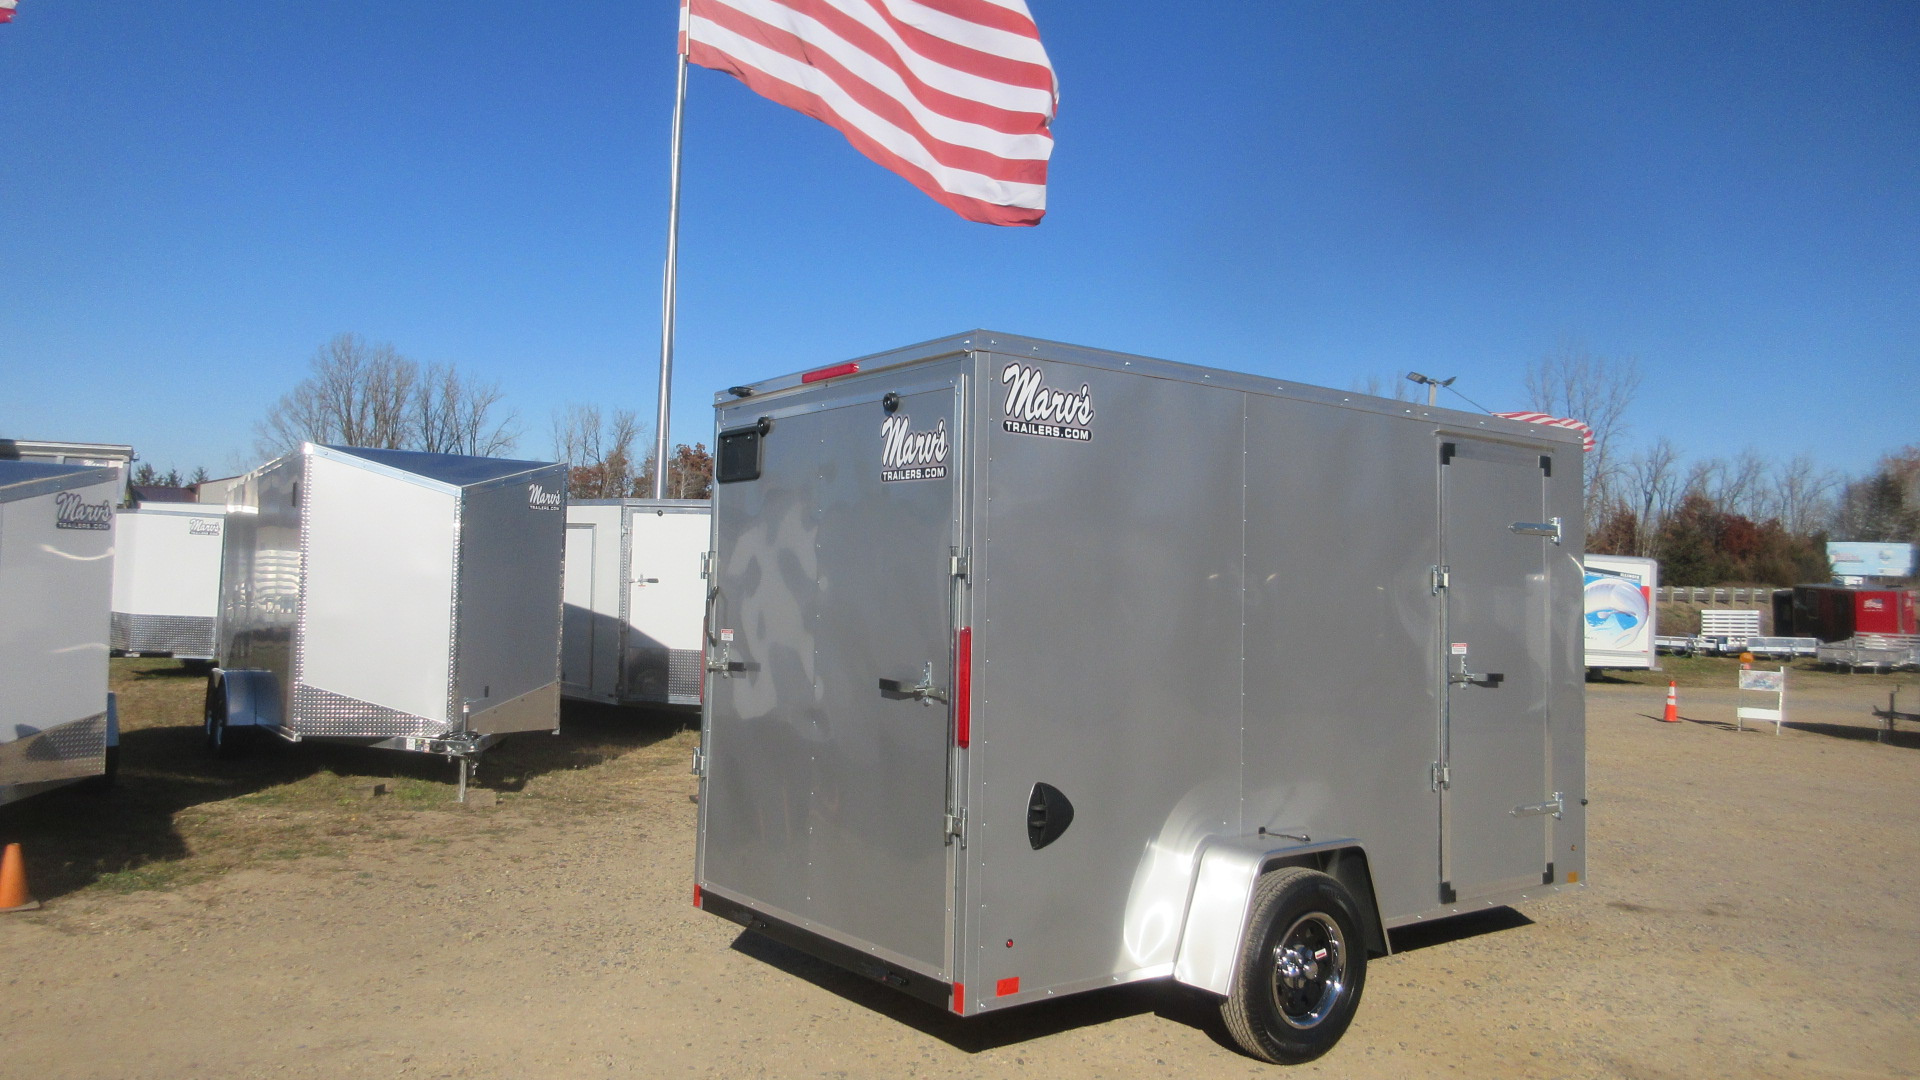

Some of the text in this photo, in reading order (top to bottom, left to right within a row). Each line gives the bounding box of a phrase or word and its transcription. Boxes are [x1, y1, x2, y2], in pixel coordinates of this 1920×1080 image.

[1003, 363, 1093, 425] Marv's
[881, 416, 948, 468] Marv's
[1005, 421, 1089, 440] TRAILERS.COM
[883, 467, 944, 481] TRAILERS.COM
[56, 492, 112, 521] Marv's
[529, 484, 561, 505] Marv's
